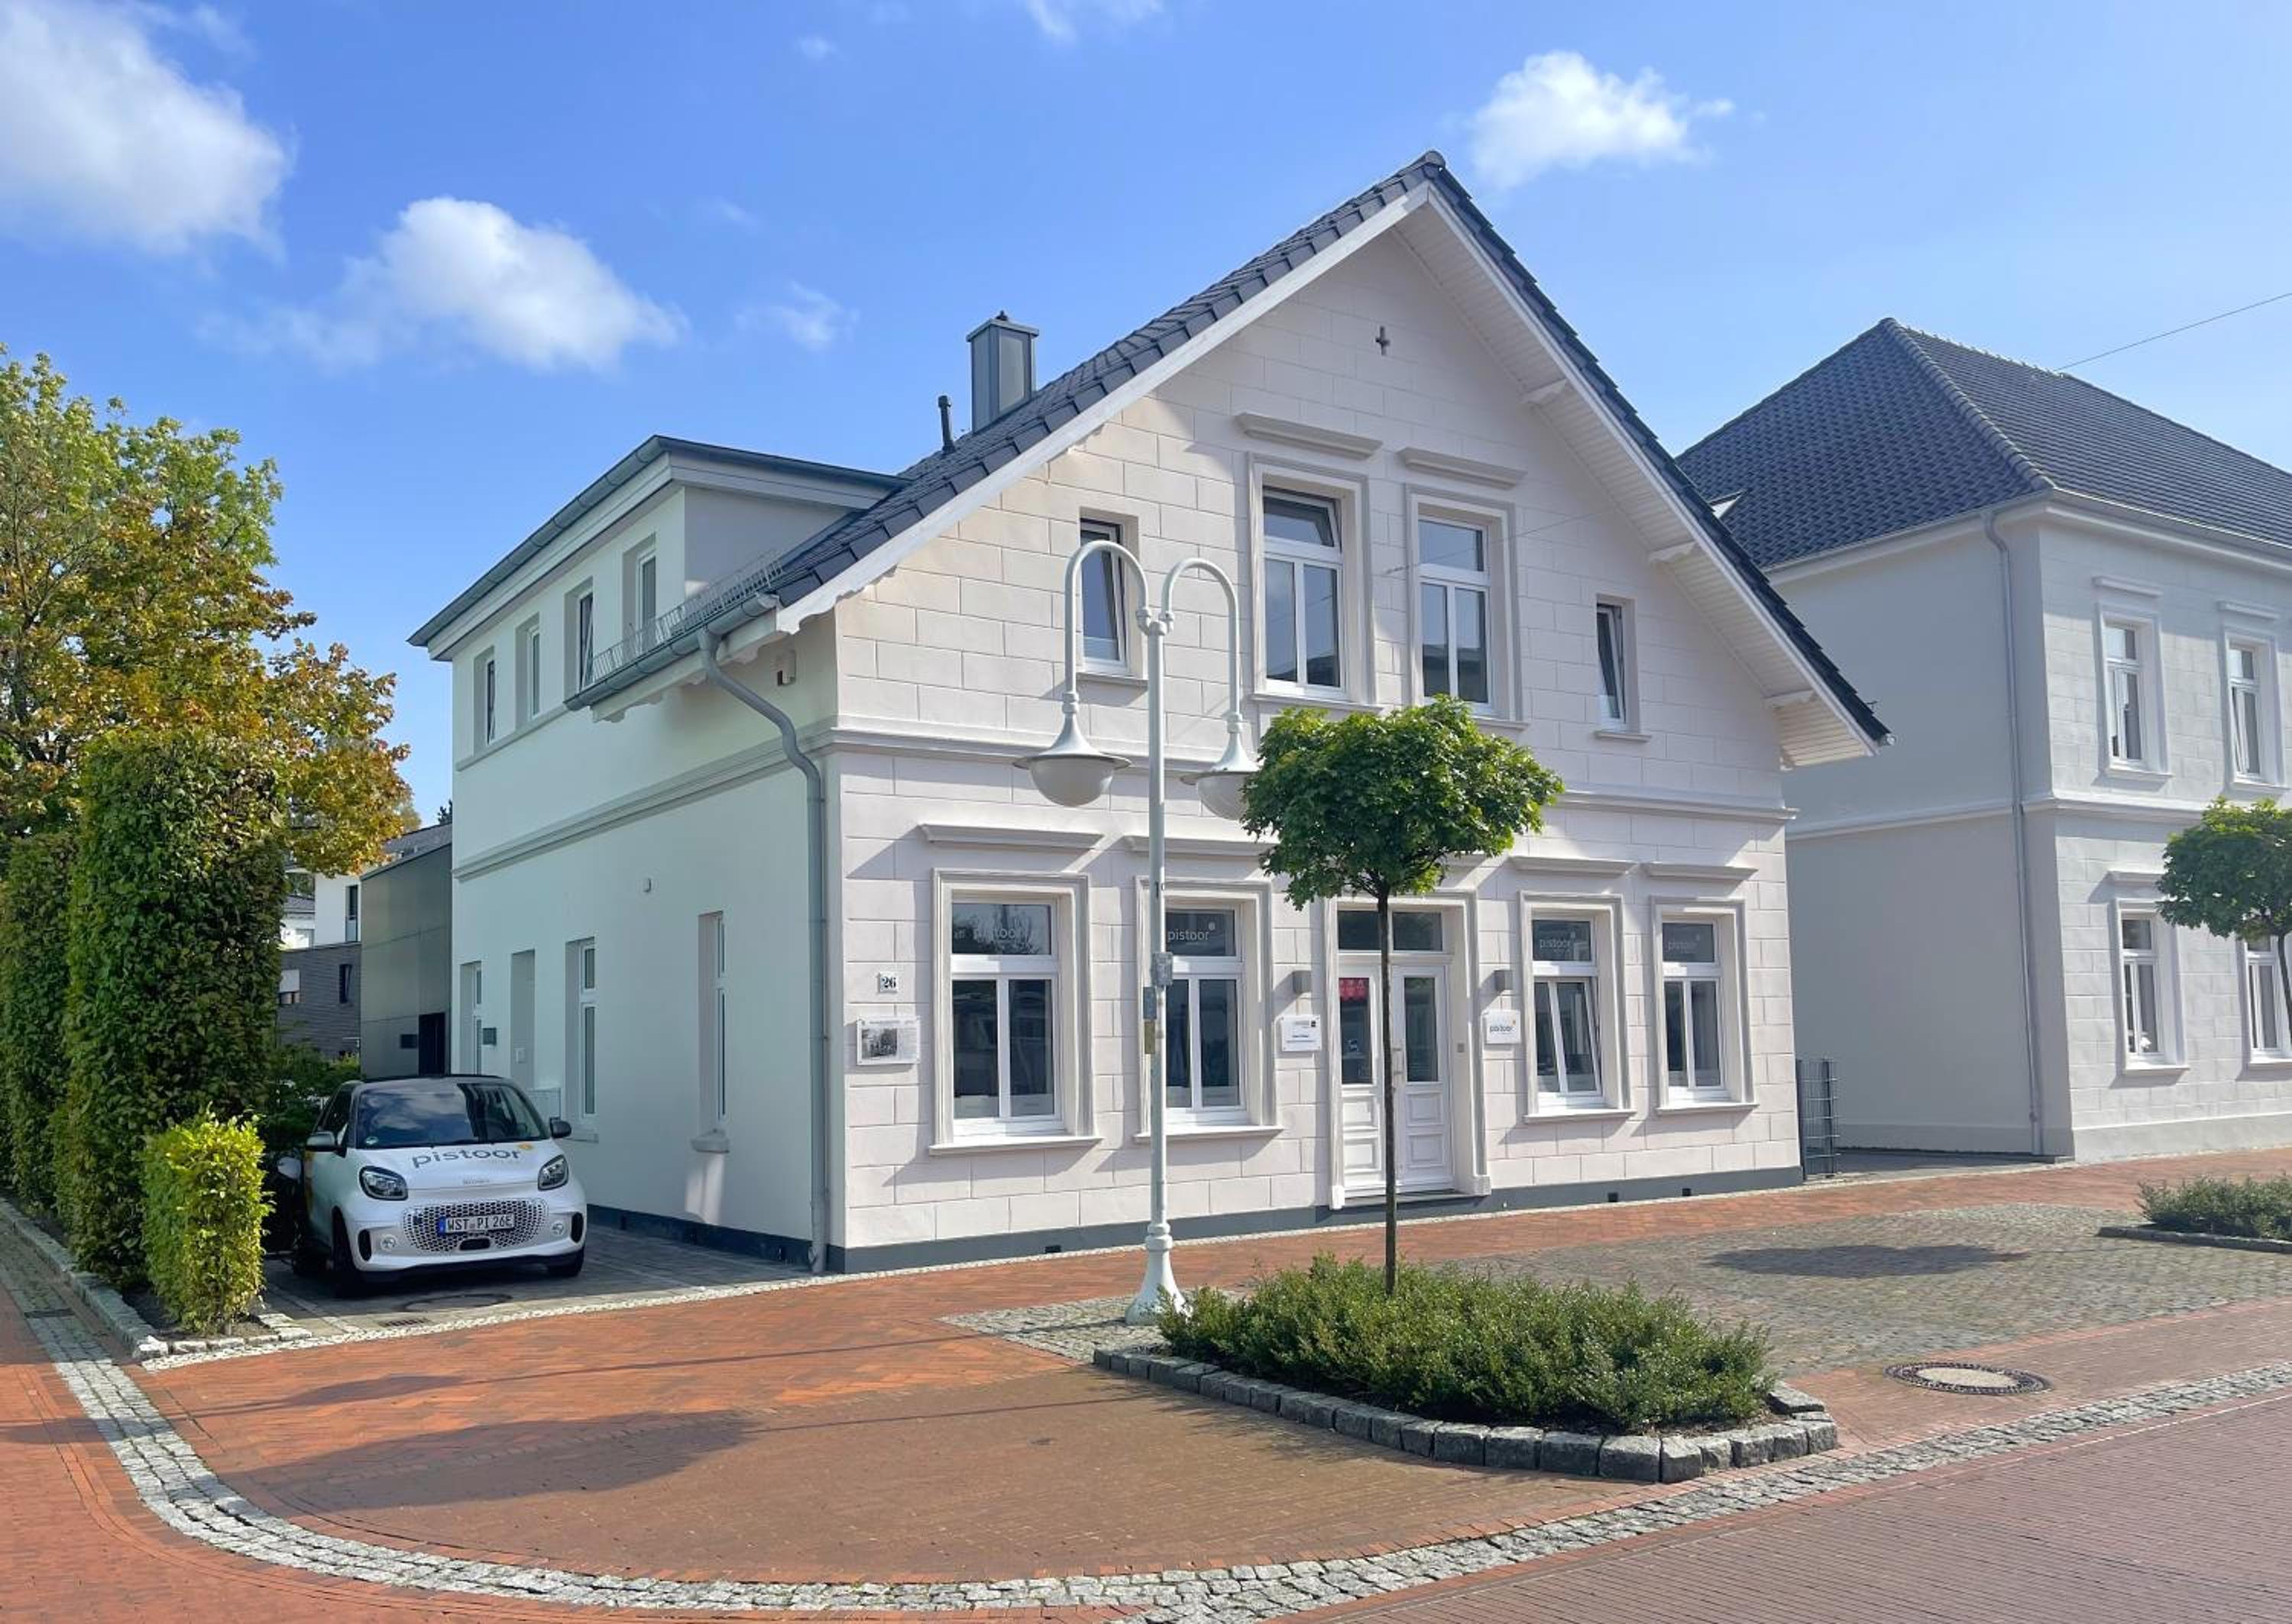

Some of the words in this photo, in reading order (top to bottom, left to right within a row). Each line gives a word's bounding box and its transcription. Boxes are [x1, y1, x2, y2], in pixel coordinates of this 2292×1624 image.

[1167, 928, 1210, 943] pistoor
[881, 975, 897, 989] 26
[412, 1150, 521, 1168] pistoor
[447, 1218, 469, 1230] WST
[477, 1218, 488, 1229] PI
[493, 1215, 512, 1227] 26E
